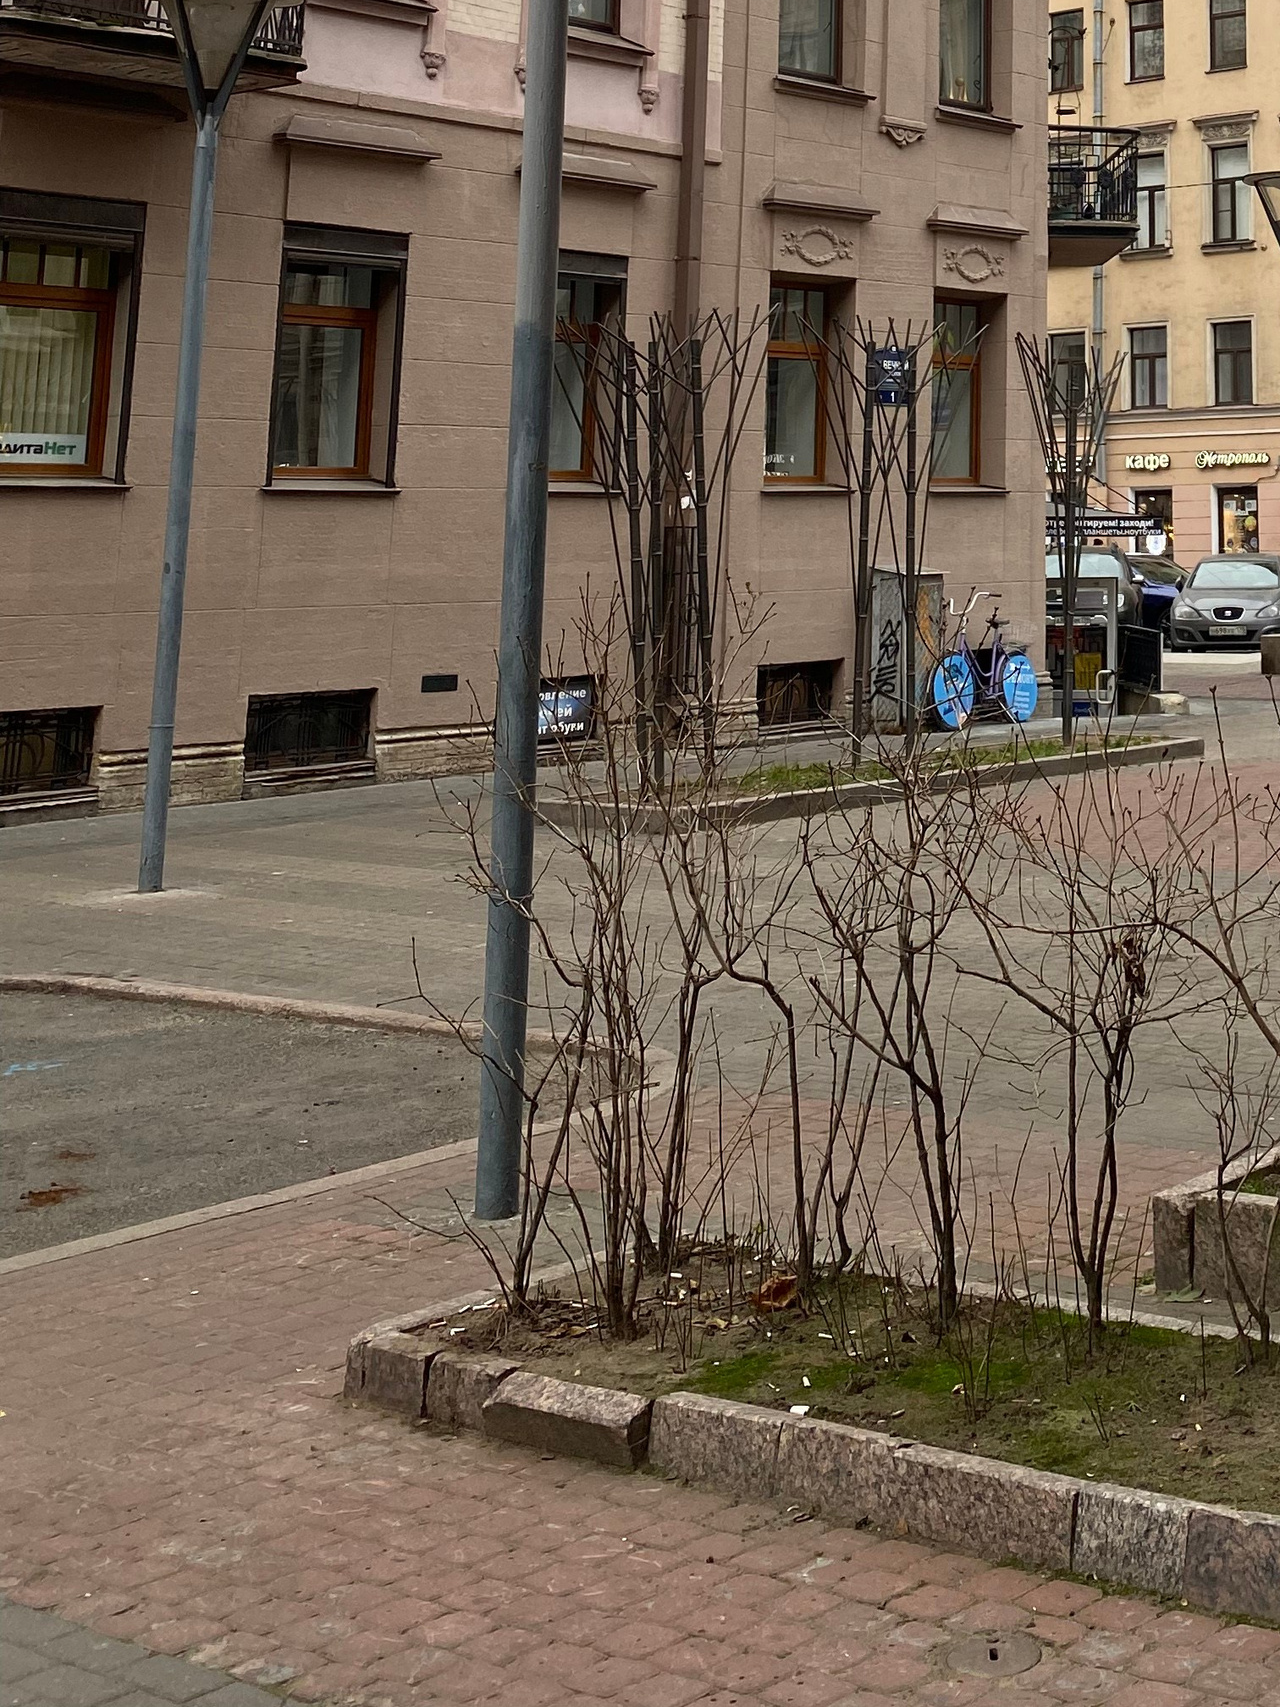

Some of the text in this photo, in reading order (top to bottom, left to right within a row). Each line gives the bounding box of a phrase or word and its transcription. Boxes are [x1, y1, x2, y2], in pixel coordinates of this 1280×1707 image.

[890, 391, 895, 403] 1
[1125, 453, 1170, 471] кафе
[1195, 450, 1270, 469] Метрополь
[1119, 519, 1154, 529] заходи!
